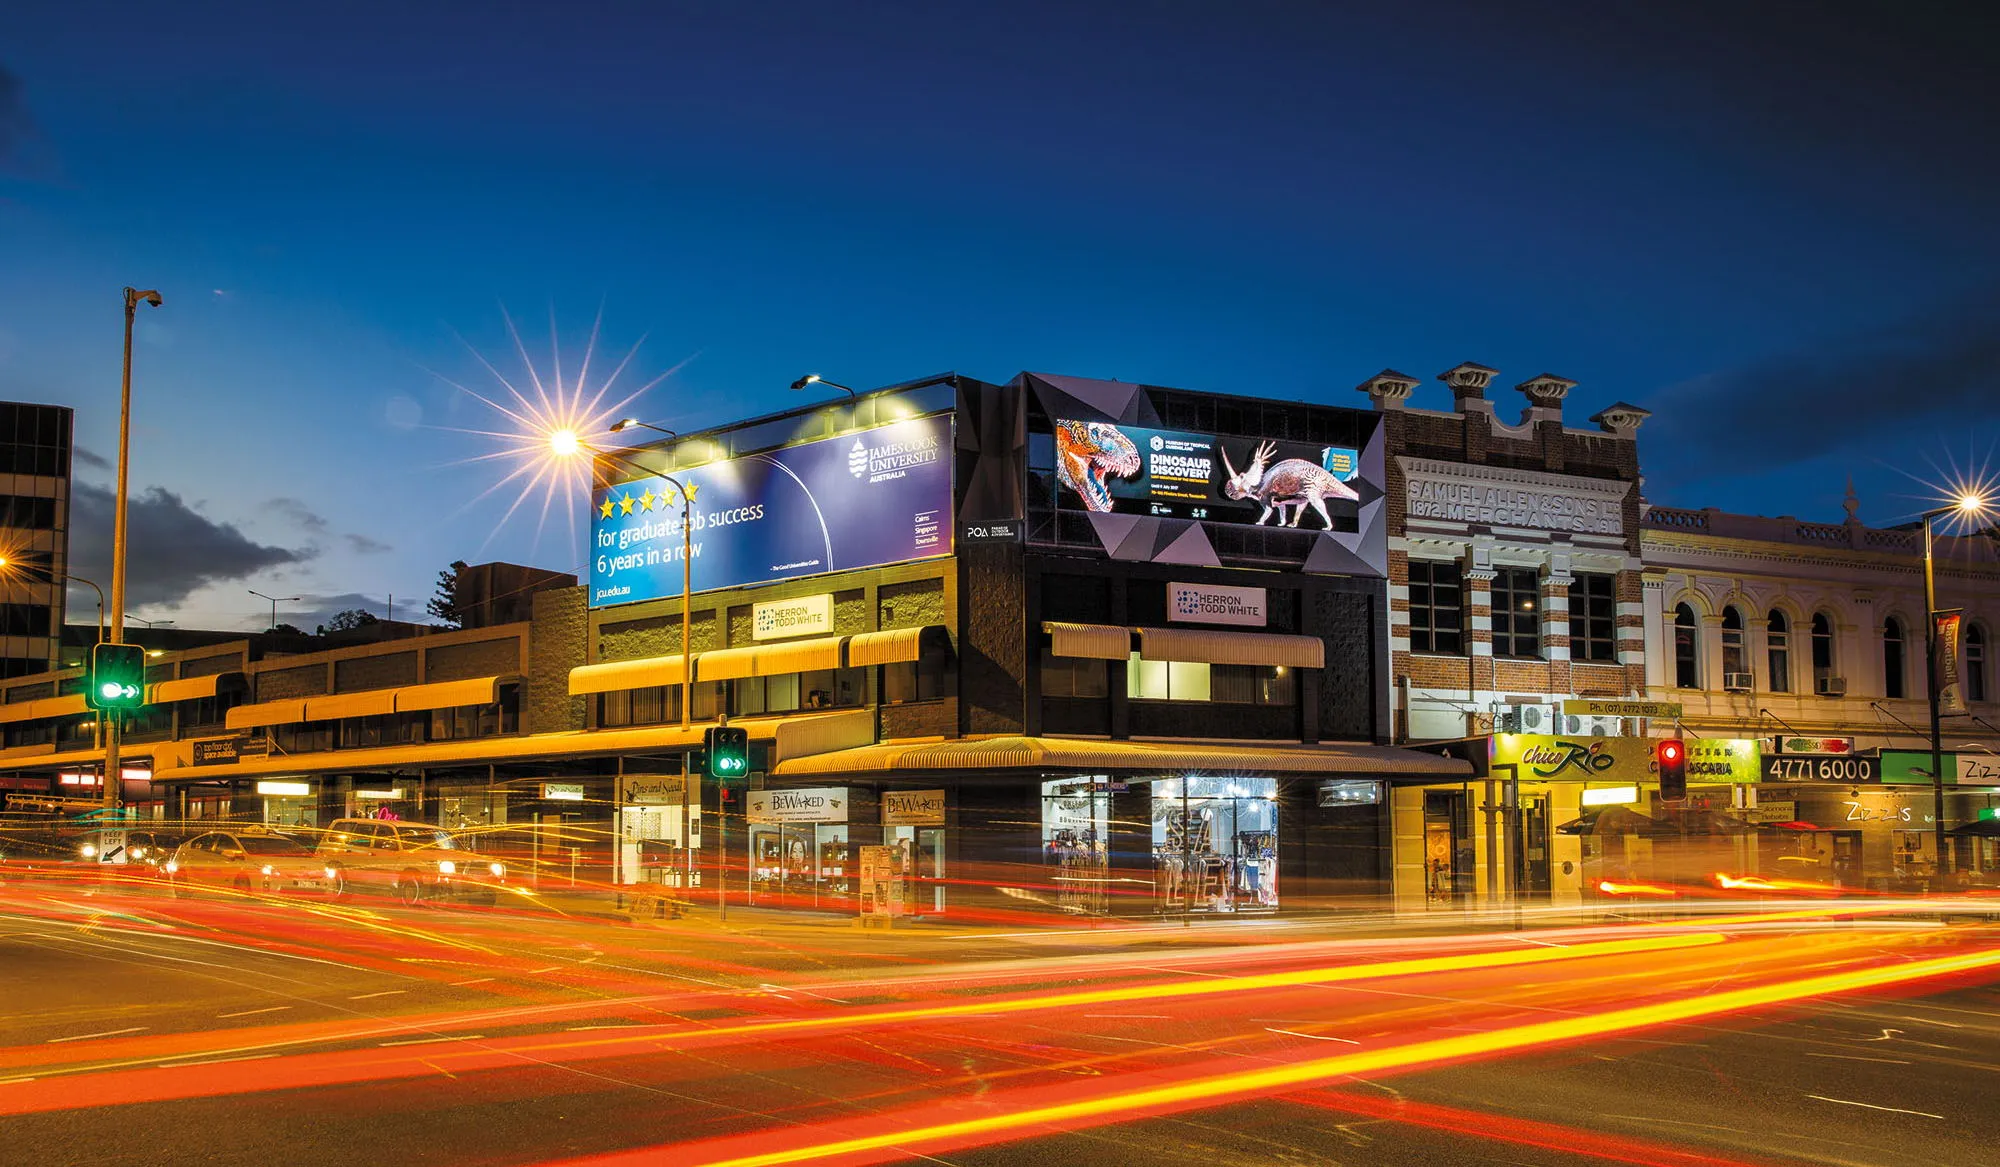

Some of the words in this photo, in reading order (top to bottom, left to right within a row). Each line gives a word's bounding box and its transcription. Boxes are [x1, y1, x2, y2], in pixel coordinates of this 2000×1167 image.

[870, 443, 903, 460] JAMES
[905, 436, 938, 452] COOK
[870, 448, 938, 472] UNIVERSITY
[1150, 454, 1210, 470] DINOSAUR
[870, 470, 906, 483] AUSTRALIA
[1150, 464, 1211, 479] DISCOVERY
[1408, 479, 1480, 505] SAMUEL
[1484, 488, 1539, 511] ALLEN
[1552, 494, 1598, 515] SONS
[598, 529, 616, 548] for
[619, 520, 678, 550] graduate
[709, 504, 764, 528] success
[598, 555, 606, 573] 6
[609, 552, 644, 577] years
[647, 547, 660, 564] in
[663, 550, 672, 562] a
[596, 584, 630, 601] jcu.edu.au
[1200, 594, 1241, 605] HERRON
[775, 607, 808, 618] HERRON
[1200, 604, 1226, 613] TODD
[1228, 606, 1259, 616] WHITE
[775, 617, 795, 627] TODD
[797, 614, 822, 624] WHITE
[1944, 623, 1957, 682] Basketball
[1590, 703, 1602, 712] Ph.
[1605, 704, 1620, 713] (07)
[1623, 705, 1640, 713] 4772
[1770, 760, 1813, 779] 4771
[1819, 760, 1871, 780] 6000
[1962, 760, 2000, 778] Ziz
